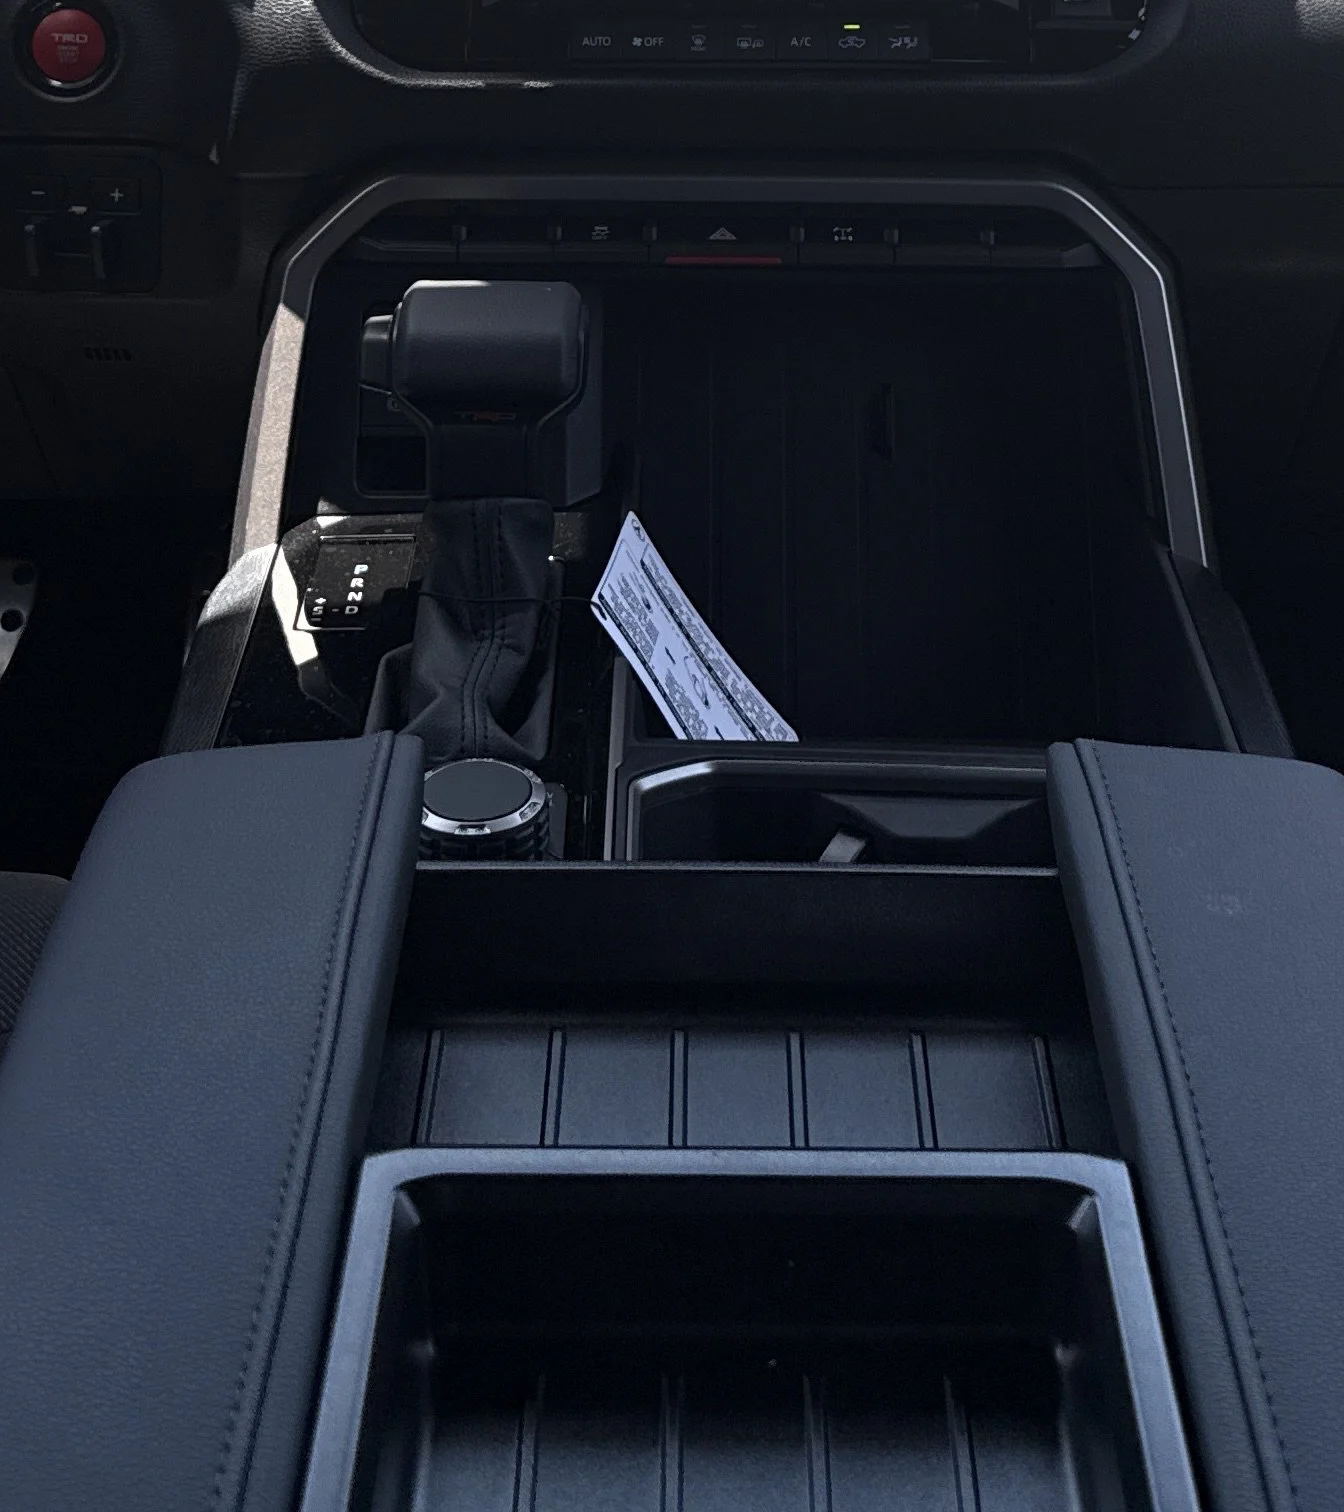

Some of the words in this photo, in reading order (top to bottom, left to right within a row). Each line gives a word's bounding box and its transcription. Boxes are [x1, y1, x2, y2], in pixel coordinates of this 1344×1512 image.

[582, 36, 612, 47] AUTO
[643, 36, 664, 47] OFF
[790, 36, 812, 48] A/C
[353, 563, 369, 575] P
[349, 577, 365, 589] R
[346, 591, 364, 602] N
[344, 605, 359, 615] D
